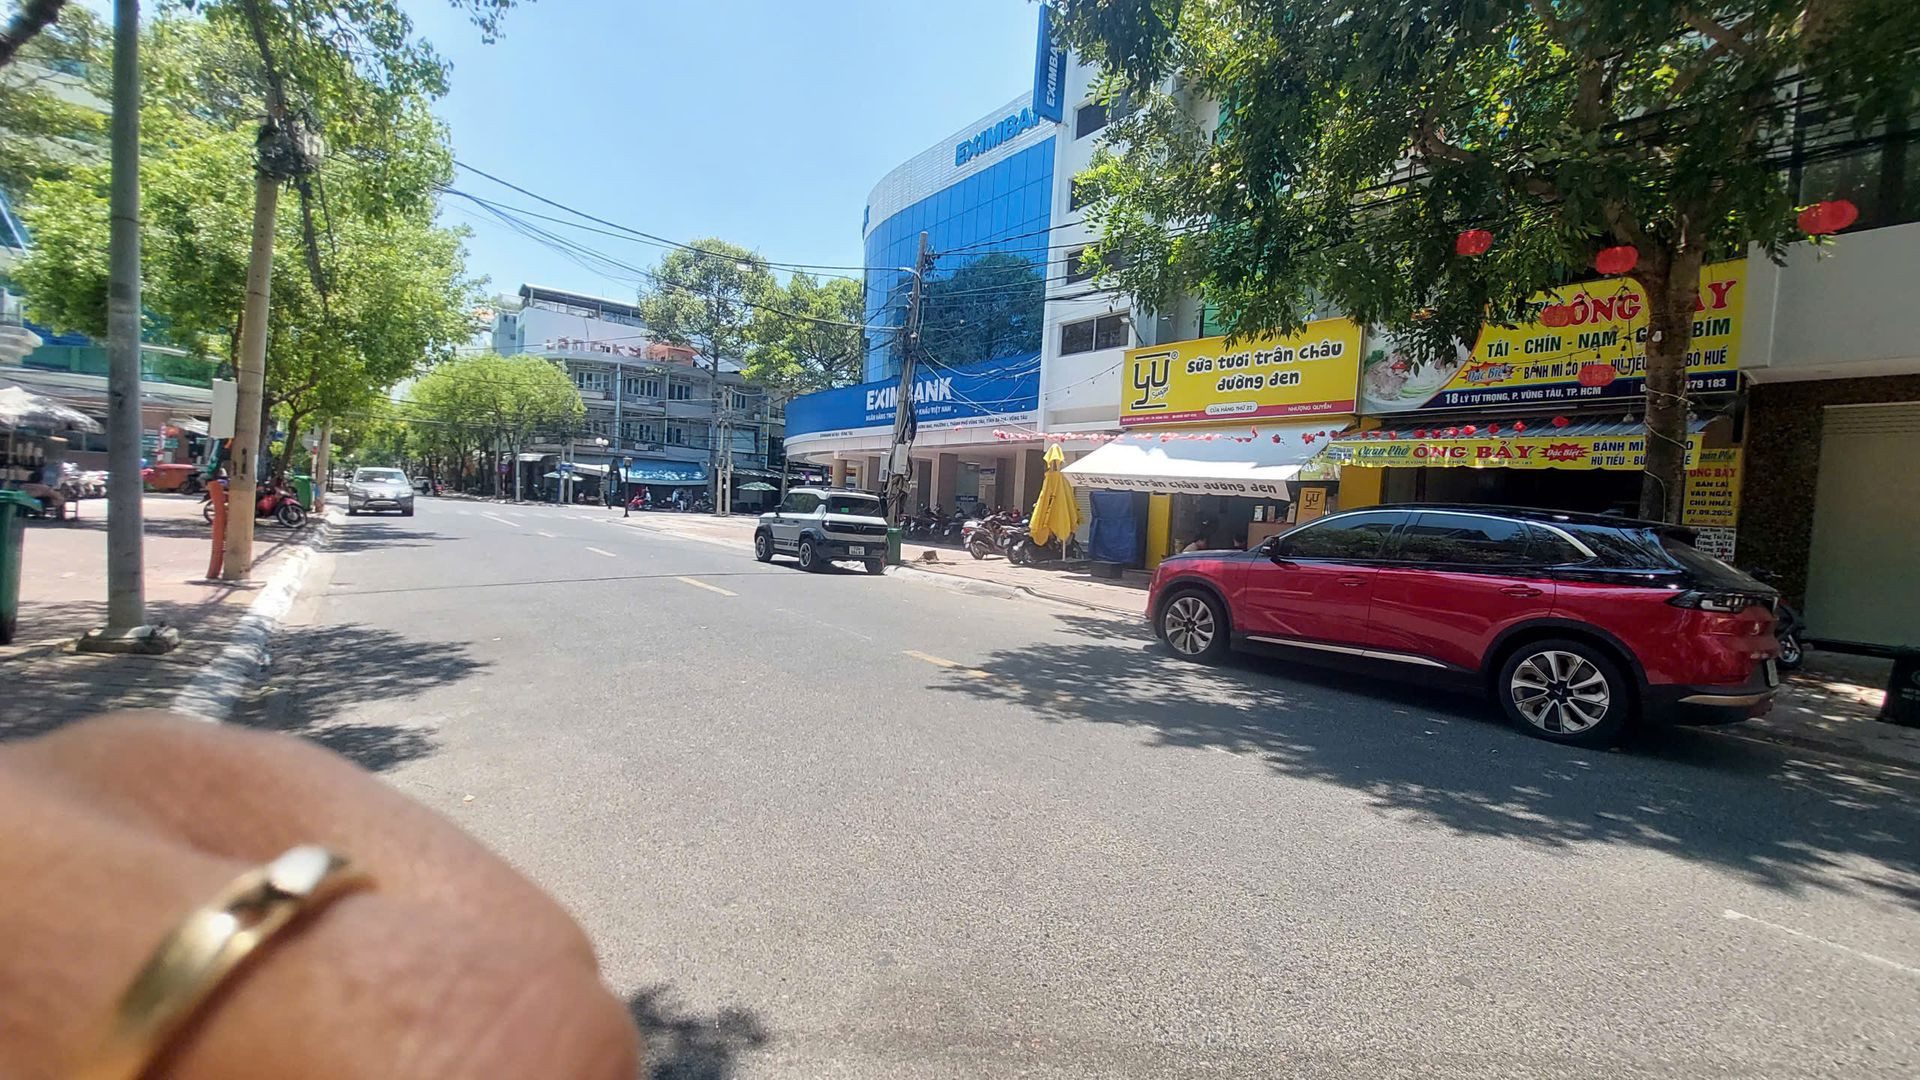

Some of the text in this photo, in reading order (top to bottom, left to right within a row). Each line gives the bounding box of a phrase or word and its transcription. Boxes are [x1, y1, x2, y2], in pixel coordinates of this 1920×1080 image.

[1568, 293, 1642, 326] ÔNG
[1692, 317, 1730, 338] BÍM
[1488, 340, 1509, 358] TÁI
[1525, 334, 1562, 354] CHÍN
[1578, 331, 1618, 352] NẠM
[1217, 353, 1249, 370] tươi
[1254, 346, 1294, 365] trân
[1299, 340, 1343, 360] châu
[1704, 345, 1728, 365] HUẾ
[1217, 372, 1300, 391] đường đen
[1707, 378, 1727, 388] 183
[1445, 393, 1458, 404] 18
[1512, 391, 1519, 400] P.
[1567, 387, 1578, 397] TP.
[1580, 387, 1601, 396] HCM
[1413, 442, 1468, 459] ÔNG
[1476, 441, 1537, 459] BẢY
[1593, 439, 1644, 452] BÁNH MÌ
[1591, 453, 1603, 465] HỦ
[1606, 452, 1625, 465] TIẾU
[1250, 482, 1278, 494] đen
